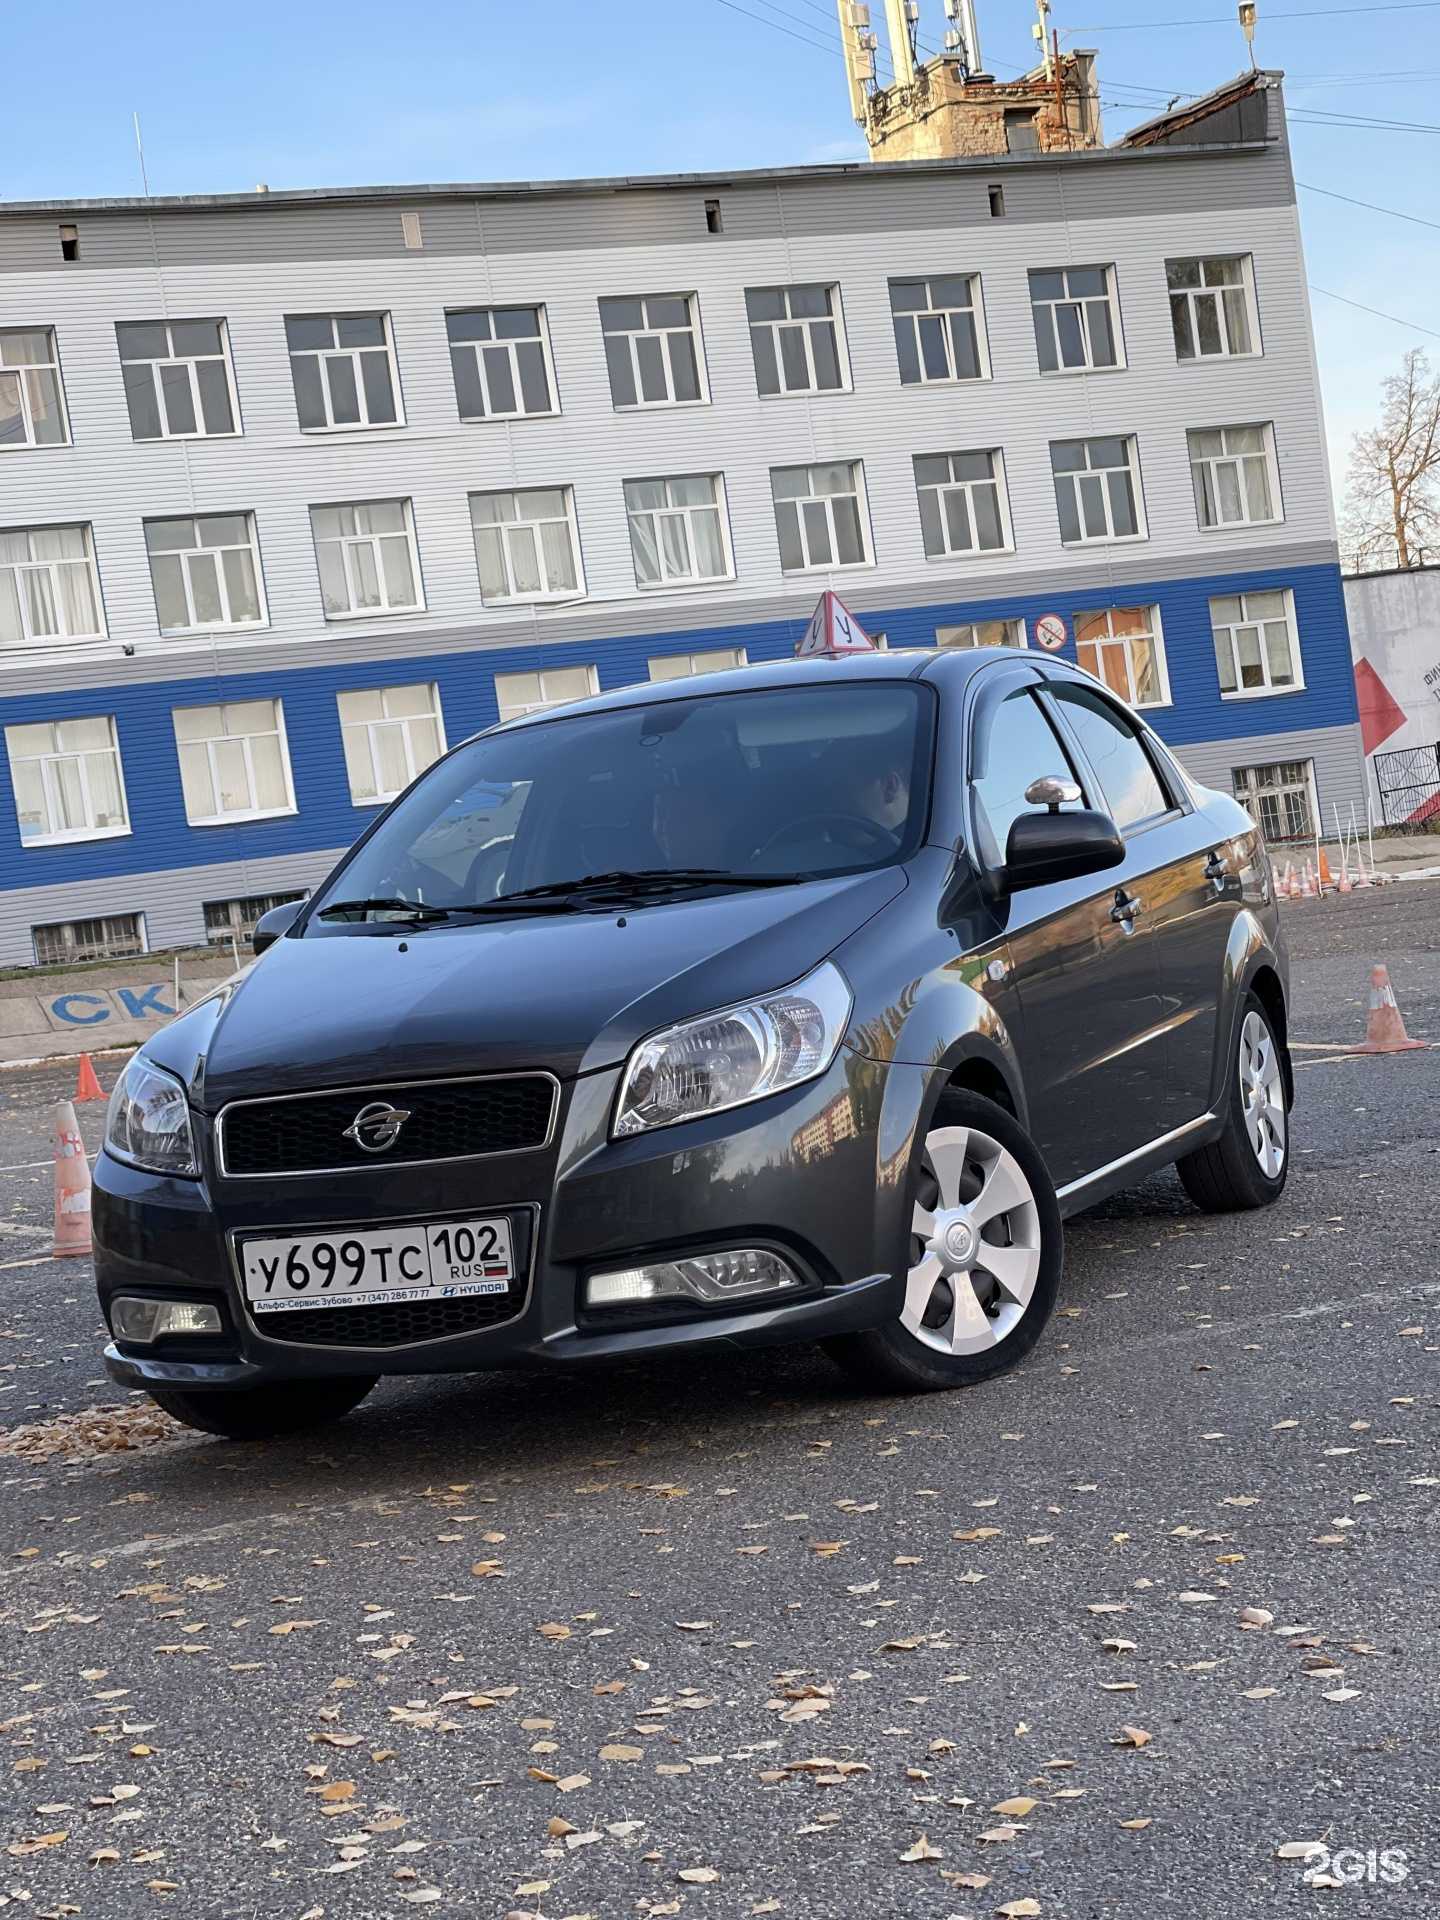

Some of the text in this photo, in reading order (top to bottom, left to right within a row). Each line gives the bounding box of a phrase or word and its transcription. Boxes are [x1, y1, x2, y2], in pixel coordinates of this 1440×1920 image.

[835, 615, 853, 644] У
[433, 1226, 500, 1265] 102
[450, 1263, 483, 1279] RUS
[460, 1282, 505, 1295] HYUNDAI
